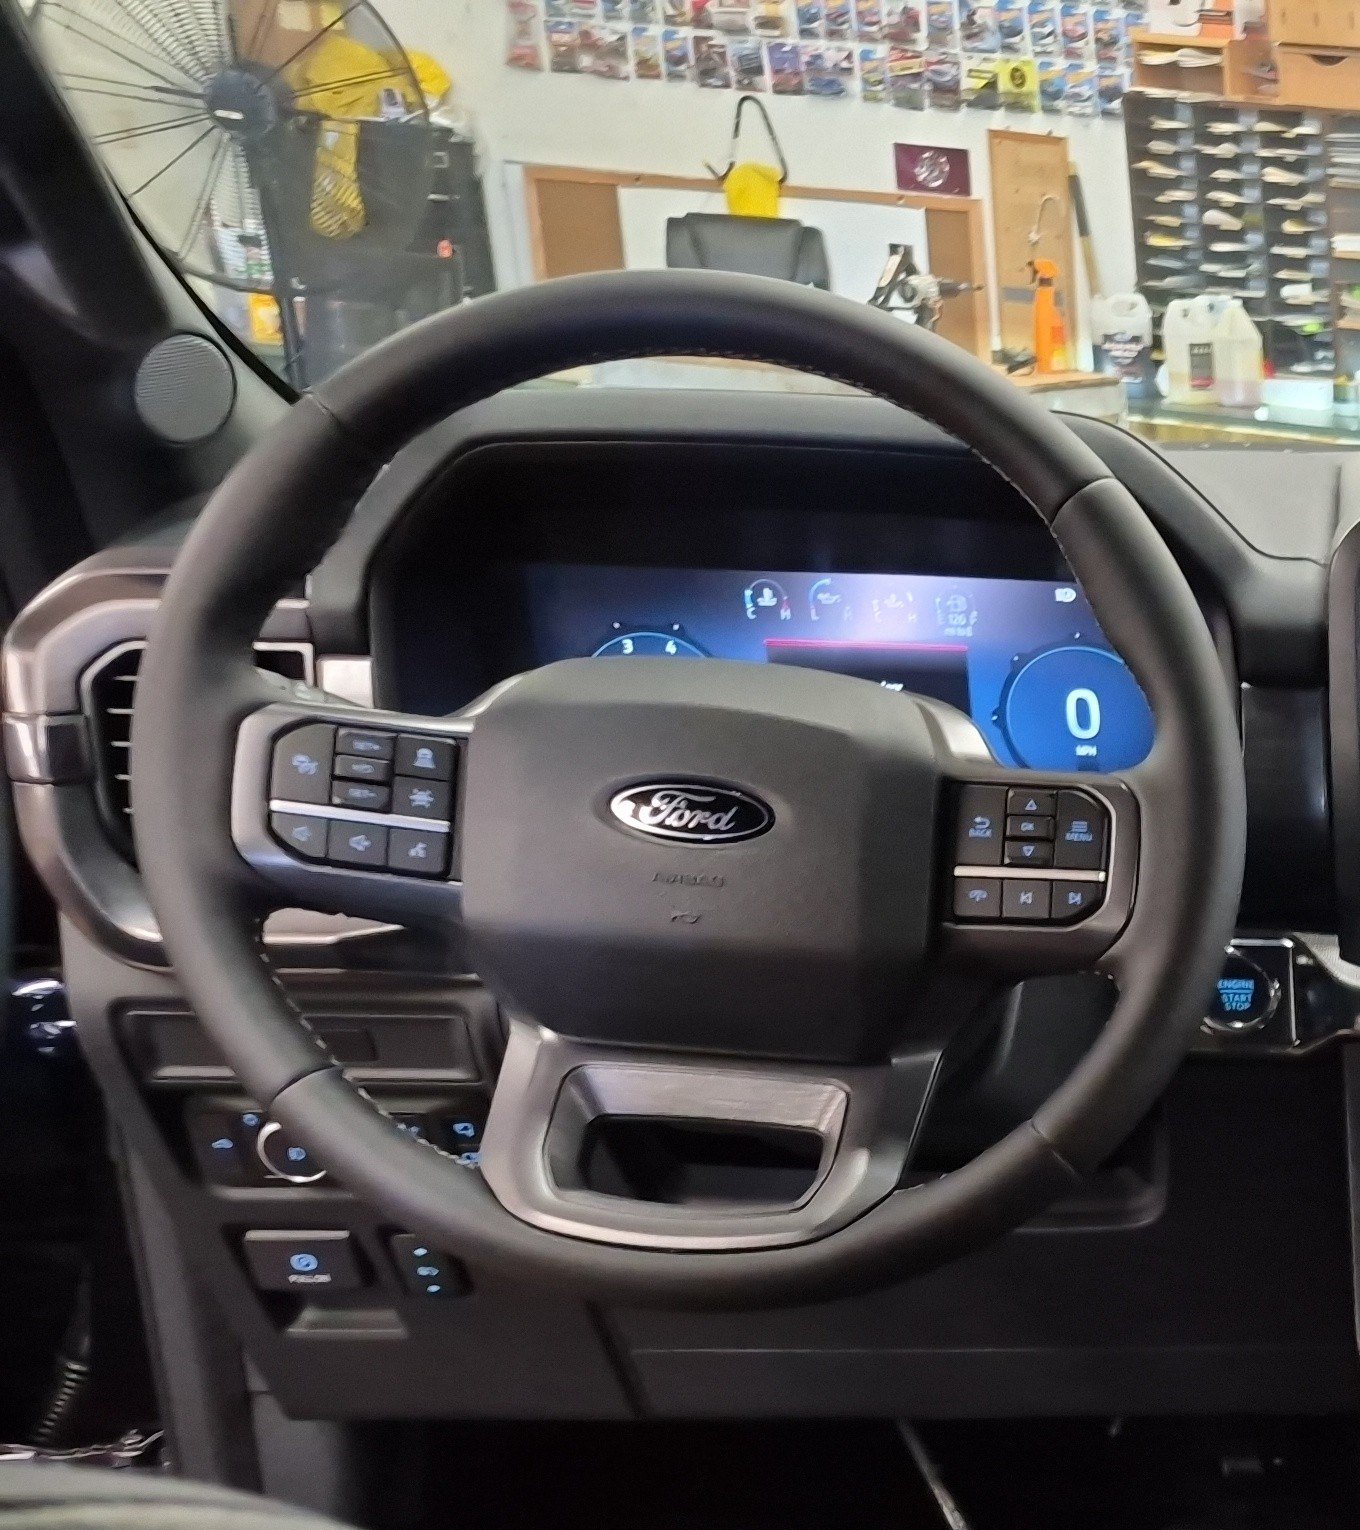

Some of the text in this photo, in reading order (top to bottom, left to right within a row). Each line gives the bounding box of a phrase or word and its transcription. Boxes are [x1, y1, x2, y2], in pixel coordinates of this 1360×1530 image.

[622, 638, 634, 654] 3
[664, 640, 677, 655] 4
[1065, 687, 1101, 740] 0
[638, 790, 738, 831] Ford
[1222, 993, 1252, 1003] START
[1224, 1002, 1251, 1011] STOP
